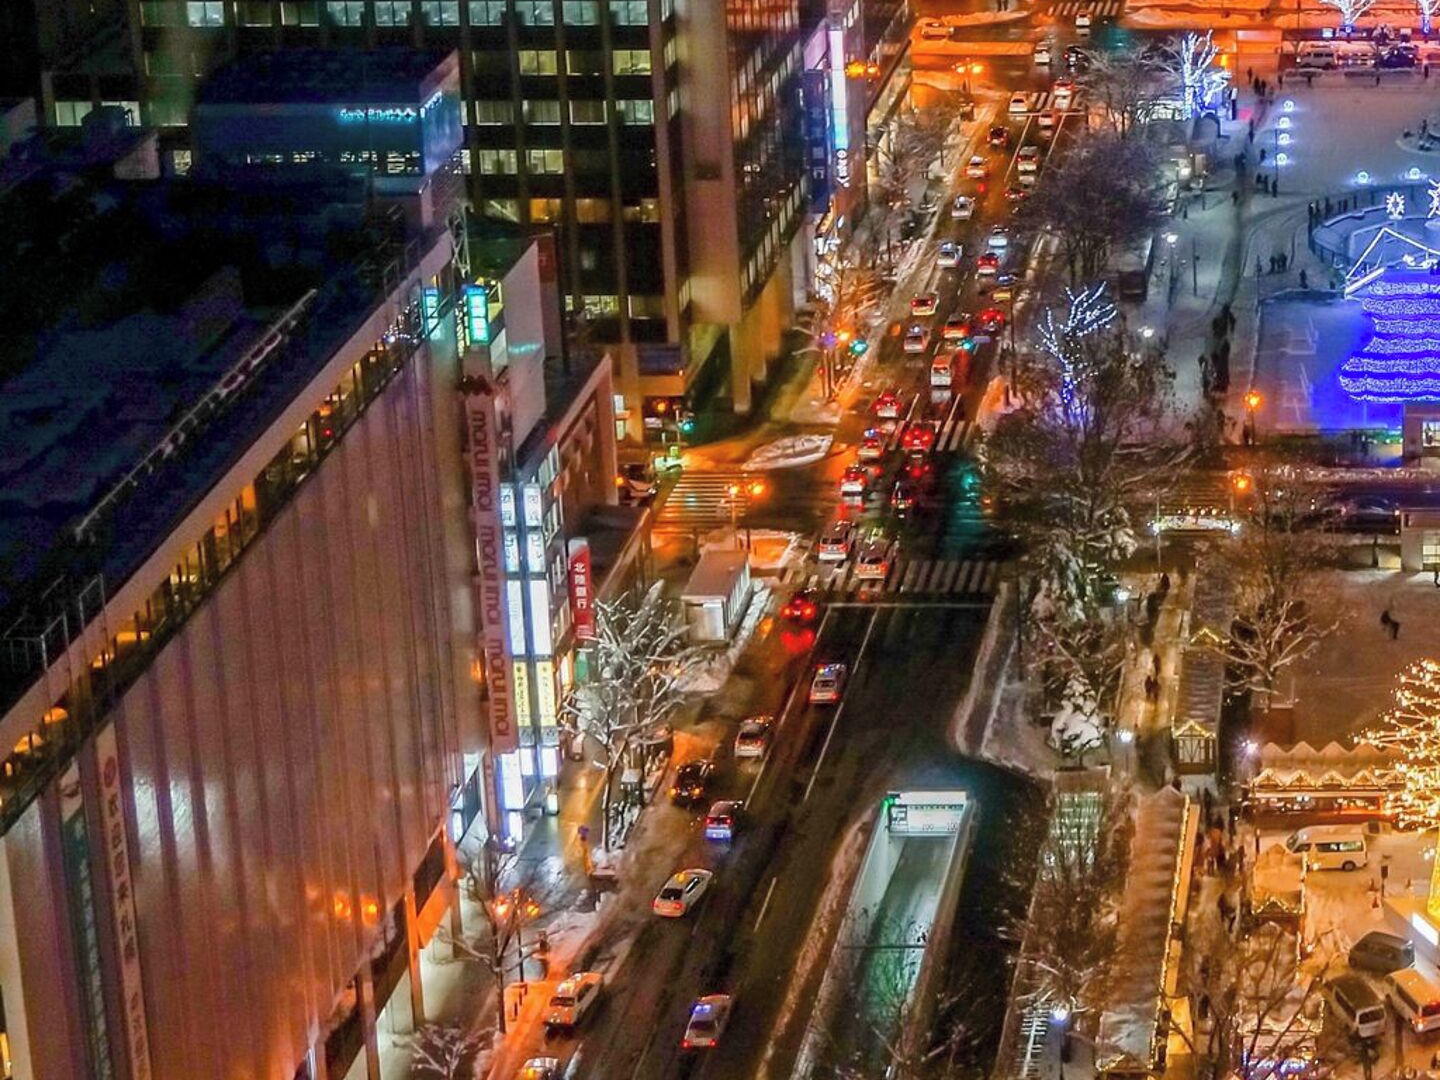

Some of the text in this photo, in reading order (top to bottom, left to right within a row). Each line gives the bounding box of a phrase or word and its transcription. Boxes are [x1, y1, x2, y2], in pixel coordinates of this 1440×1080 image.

[472, 410, 493, 512] marui imai
[480, 526, 499, 625] marui imai
[490, 639, 511, 737] marui imai
